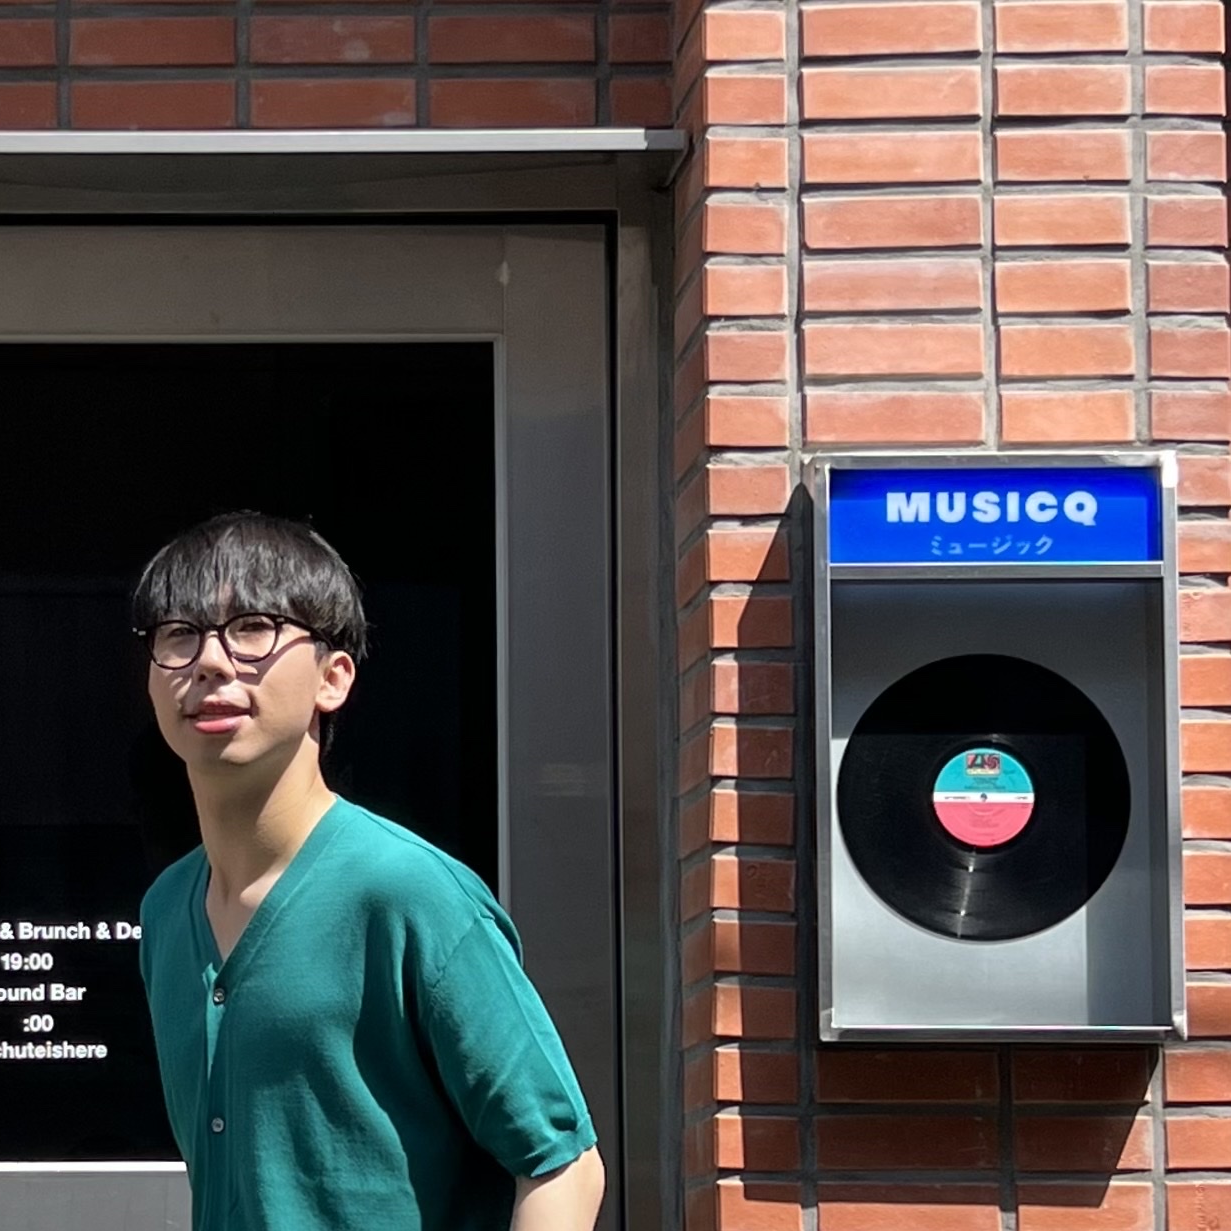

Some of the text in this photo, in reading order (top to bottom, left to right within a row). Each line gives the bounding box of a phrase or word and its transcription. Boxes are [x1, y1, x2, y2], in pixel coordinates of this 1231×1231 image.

[885, 490, 1098, 527] MUSICQ
[930, 534, 1054, 556] ミュージック
[17, 921, 91, 940] Brunch
[95, 921, 112, 940] &
[0, 952, 54, 971] 19:00
[49, 983, 87, 1002] Bar
